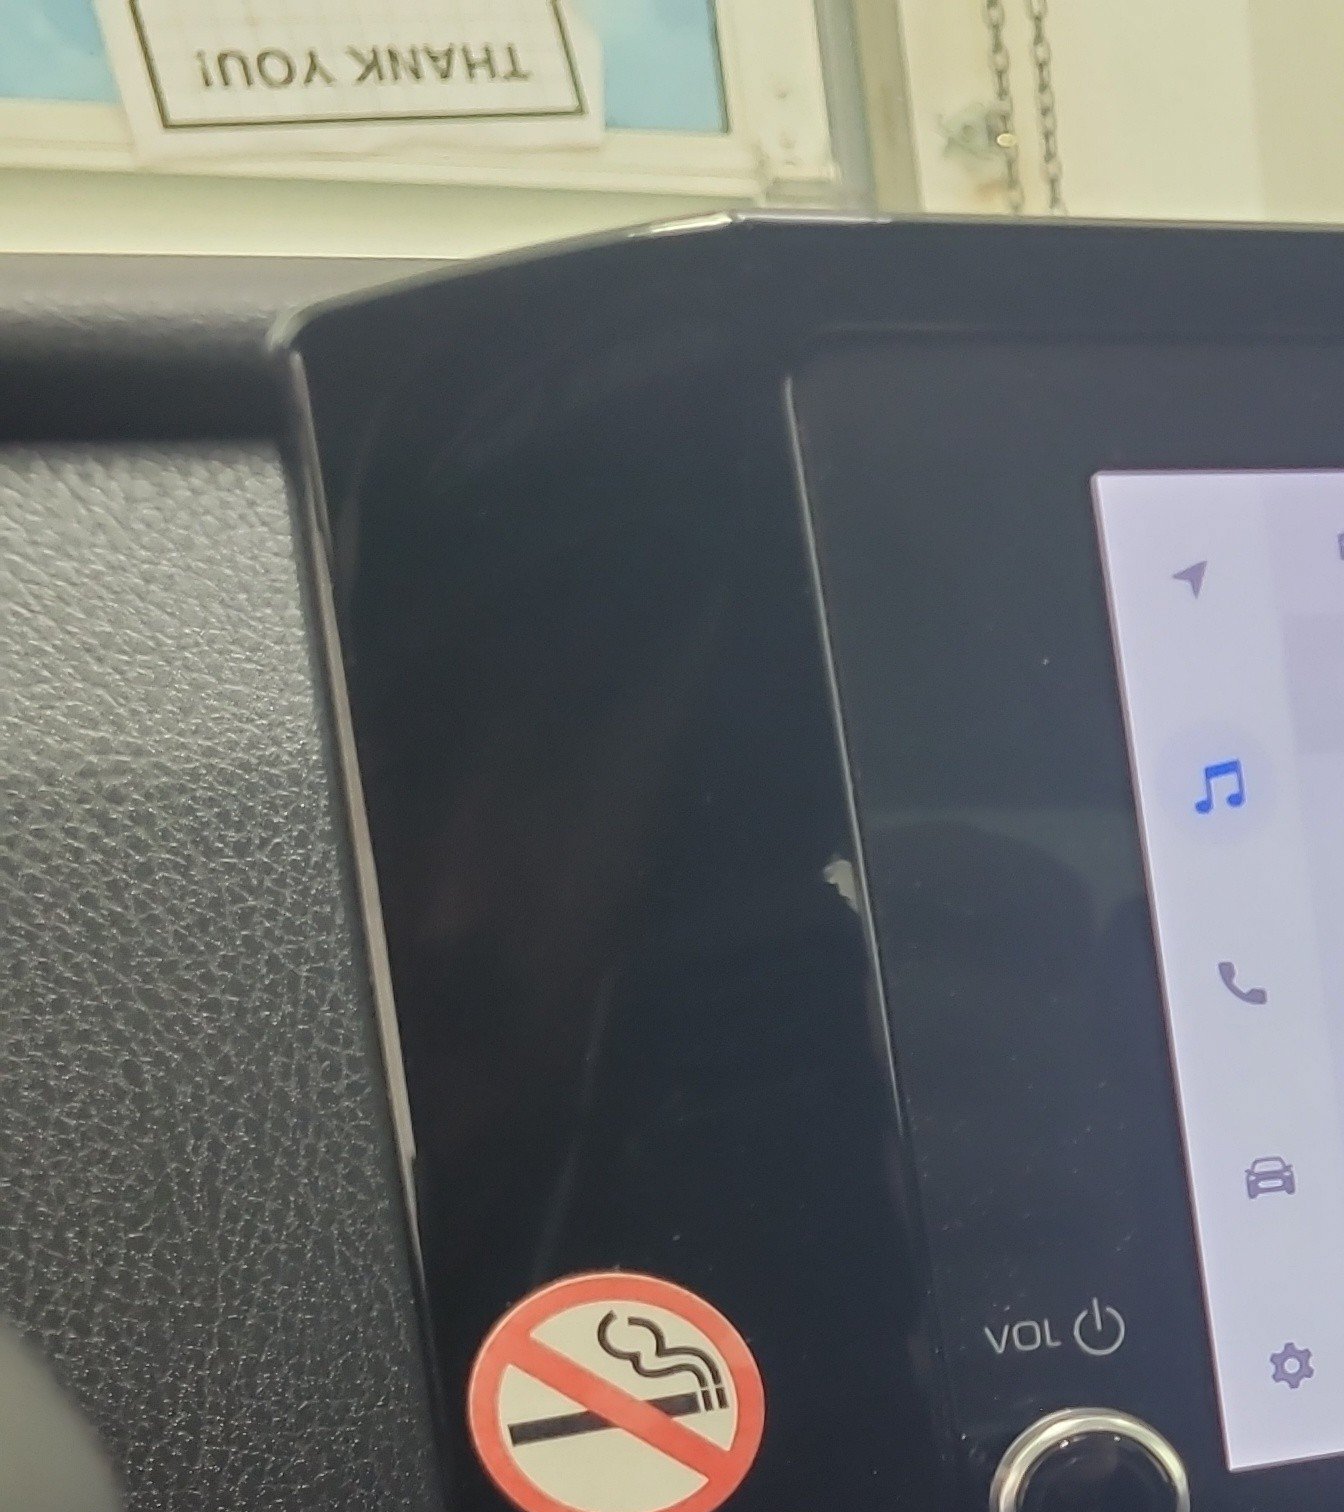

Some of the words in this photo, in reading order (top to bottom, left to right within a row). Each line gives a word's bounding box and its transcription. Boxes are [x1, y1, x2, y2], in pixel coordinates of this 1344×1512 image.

[194, 48, 332, 91] YOU!
[346, 43, 530, 85] THANK
[984, 1319, 1061, 1354] VOL
